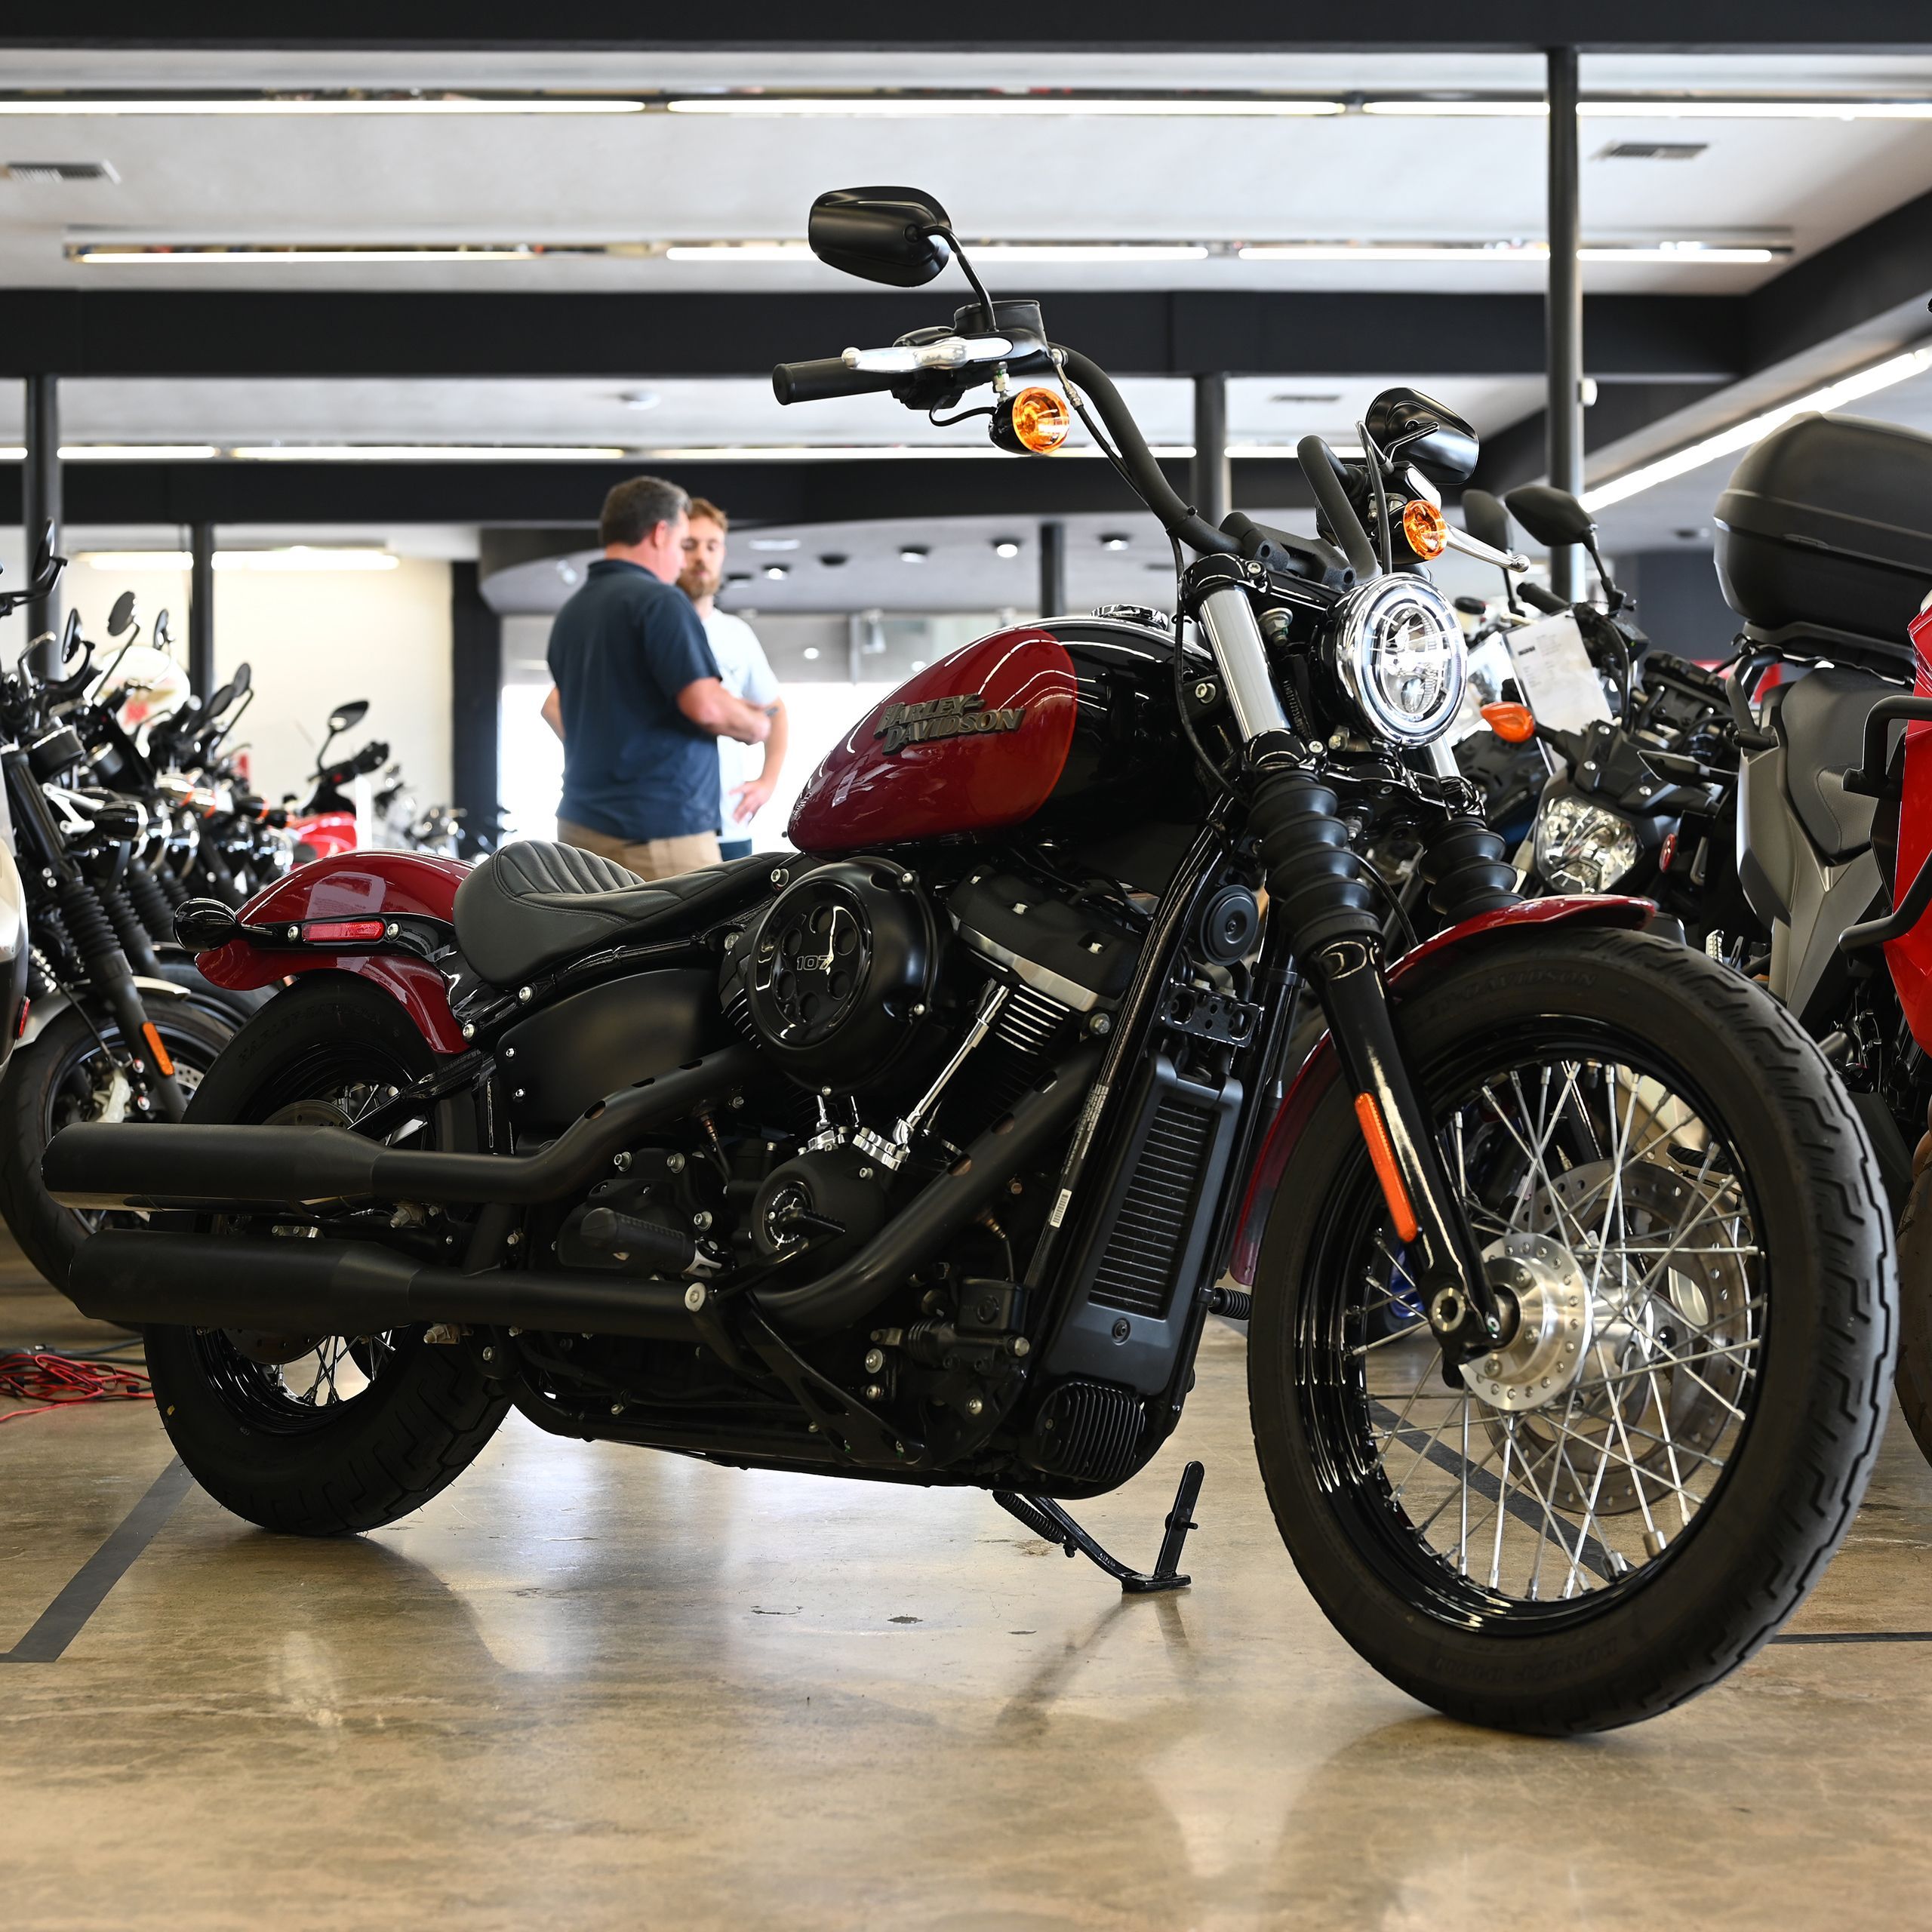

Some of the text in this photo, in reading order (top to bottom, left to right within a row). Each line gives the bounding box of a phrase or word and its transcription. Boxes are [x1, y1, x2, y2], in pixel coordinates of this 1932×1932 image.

[873, 692, 986, 740] HARLEY-
[881, 708, 1027, 756] DAVIDSON
[796, 955, 833, 971] 107
